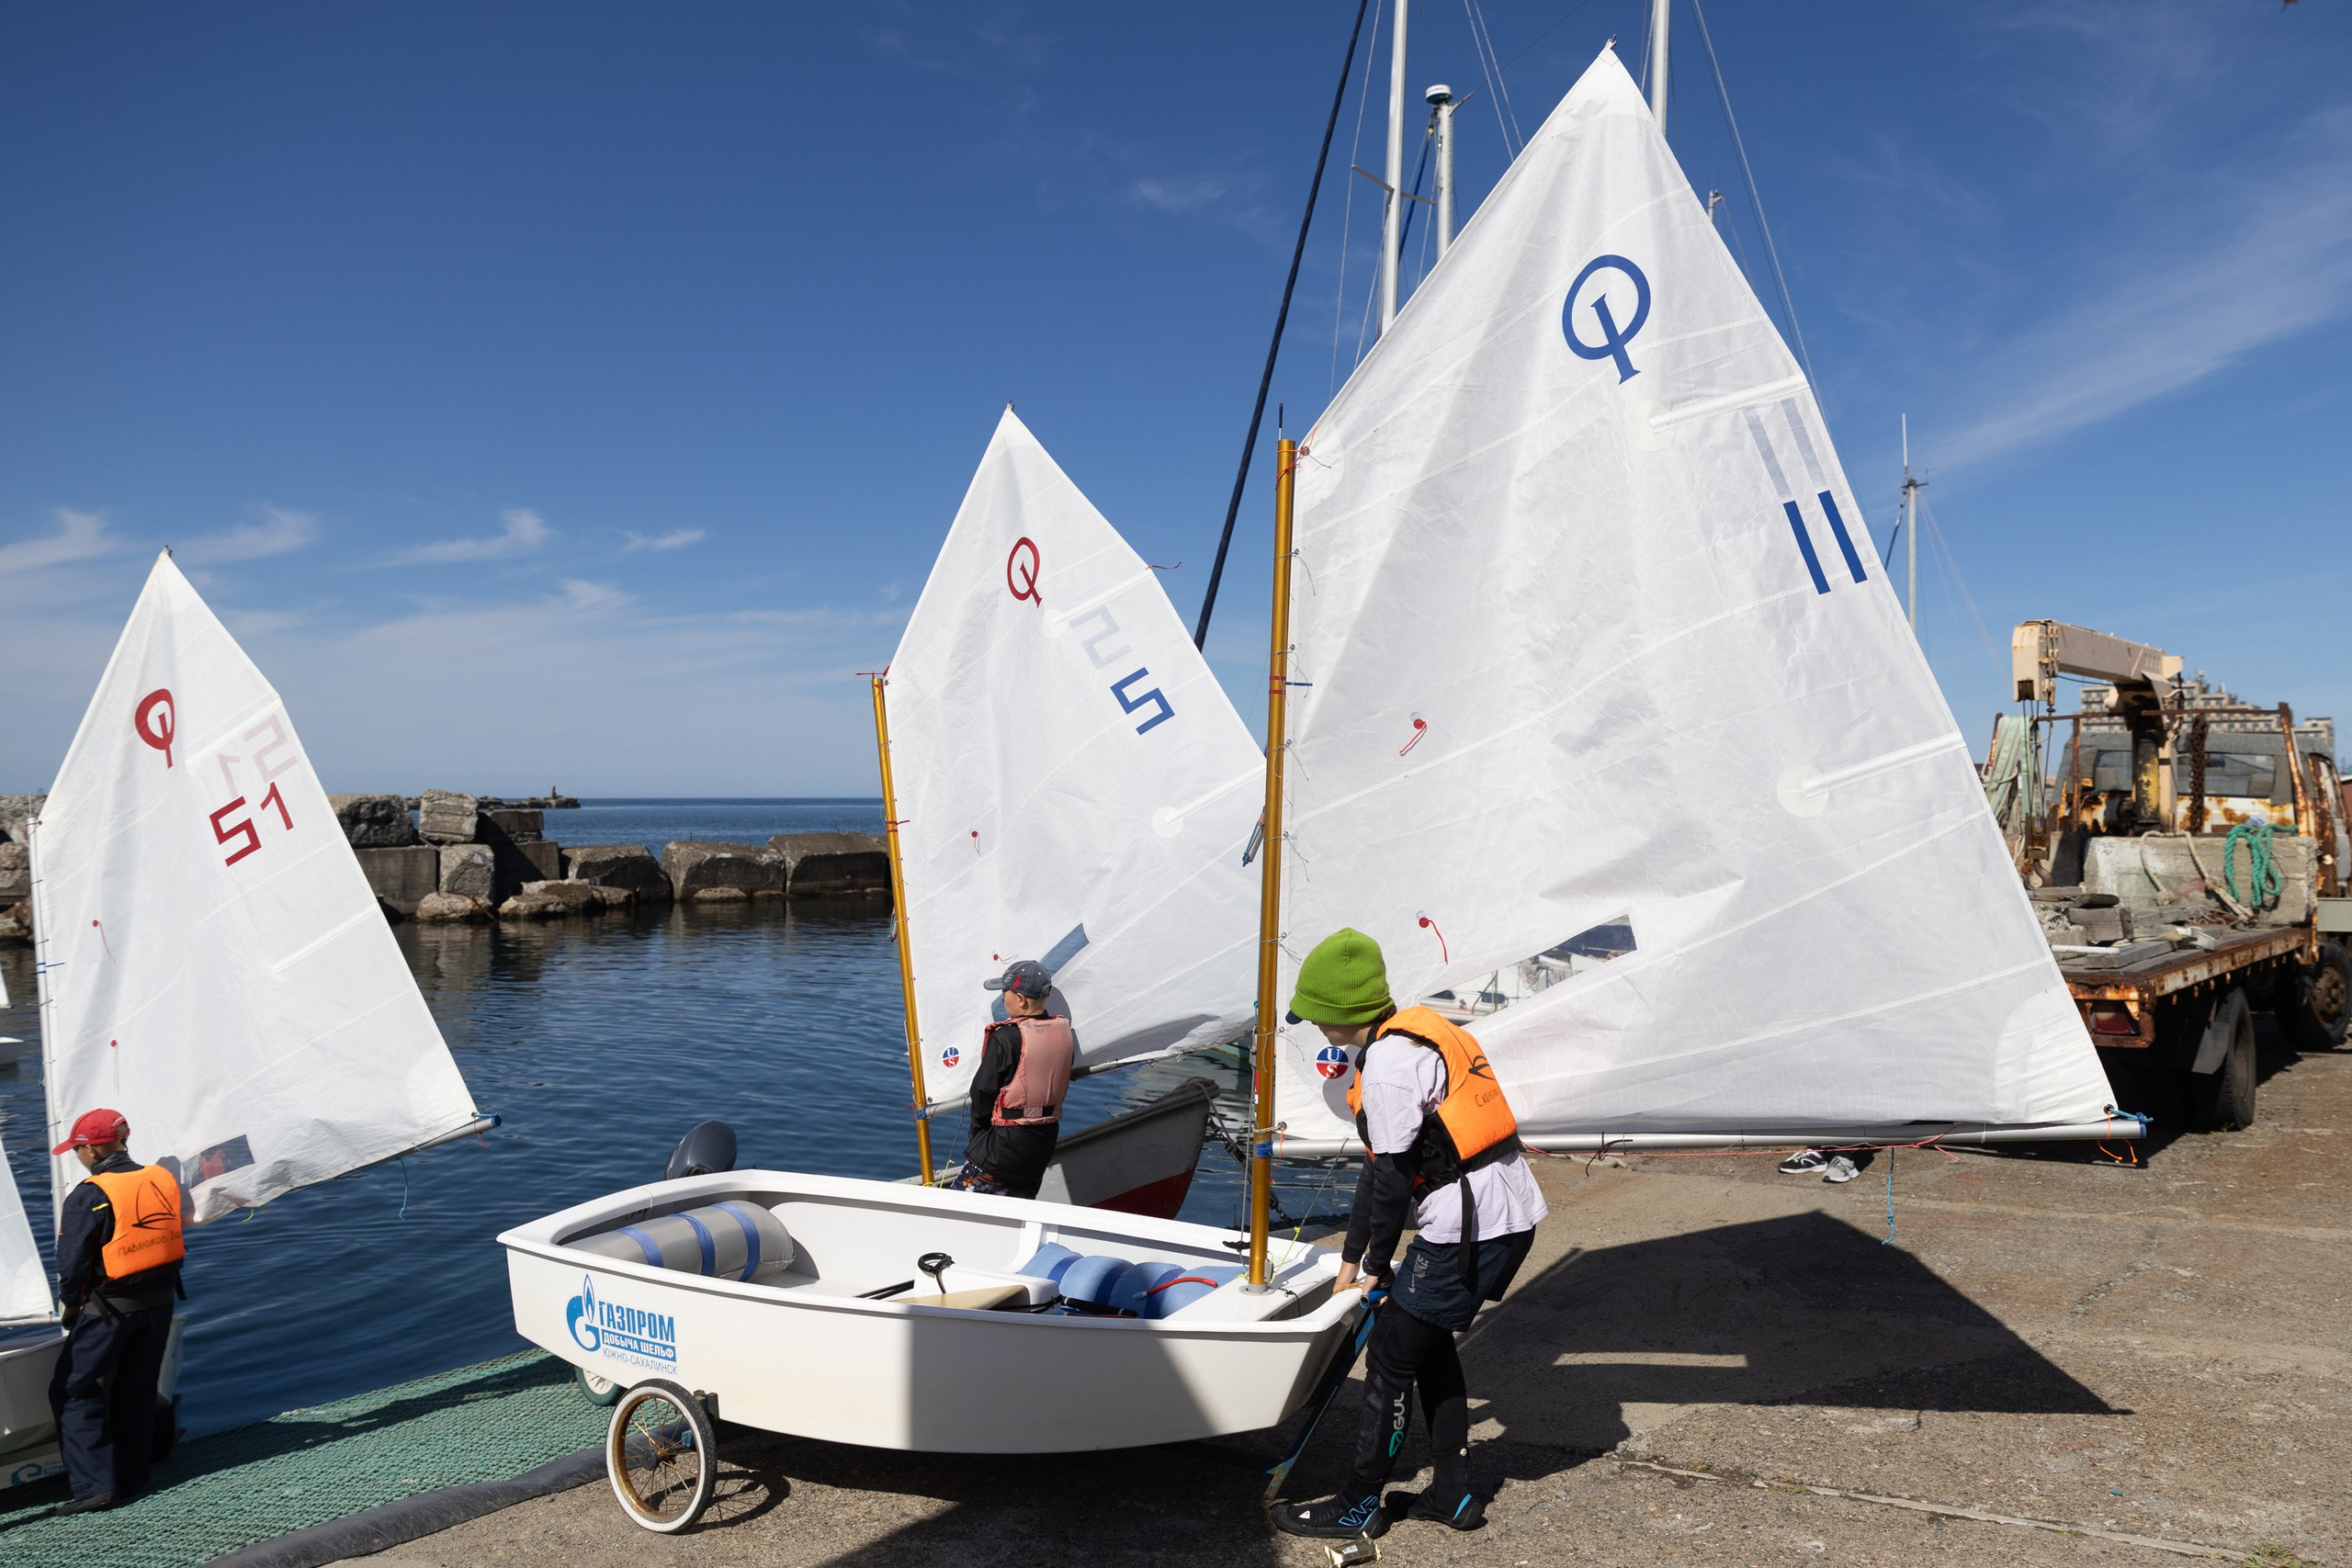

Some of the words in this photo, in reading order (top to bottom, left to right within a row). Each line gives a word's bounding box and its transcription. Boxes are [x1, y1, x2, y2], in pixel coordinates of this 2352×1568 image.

[1782, 490, 1868, 595] 11
[1109, 666, 1176, 736] 5
[209, 781, 294, 868] 51
[598, 1301, 675, 1343] ГАЗПРОМ
[603, 1347, 678, 1376] ЮЖНО-САХАЛИНСК
[604, 1331, 639, 1351] ДОБЫЧА
[639, 1341, 674, 1359] ШЕЛЬФ
[1393, 1391, 1406, 1431] GUL
